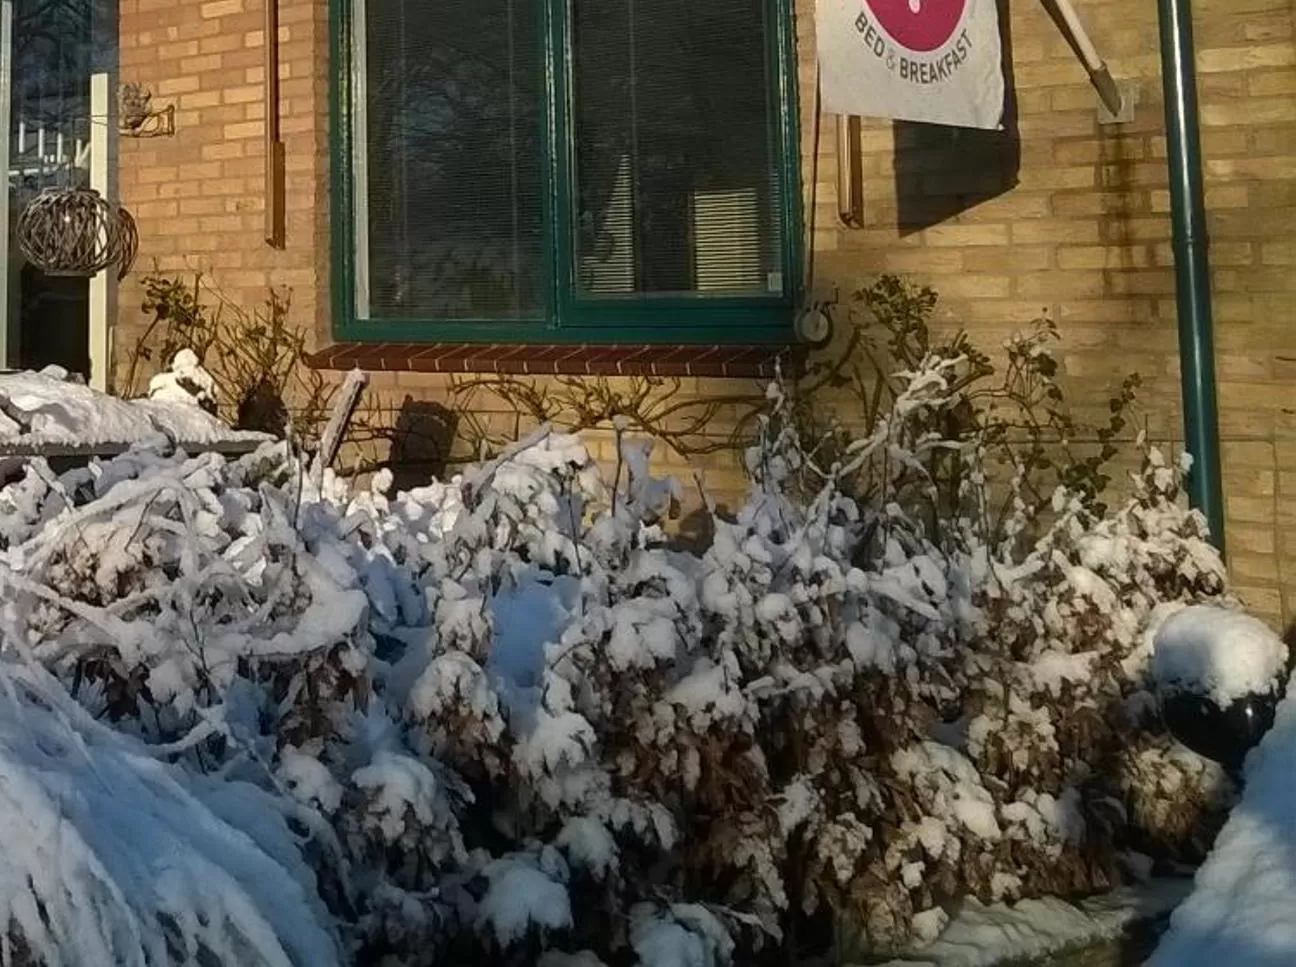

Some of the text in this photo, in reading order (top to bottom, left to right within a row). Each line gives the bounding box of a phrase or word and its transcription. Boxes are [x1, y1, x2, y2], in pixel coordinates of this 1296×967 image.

[854, 12, 972, 84] BED & BREAKFAST
